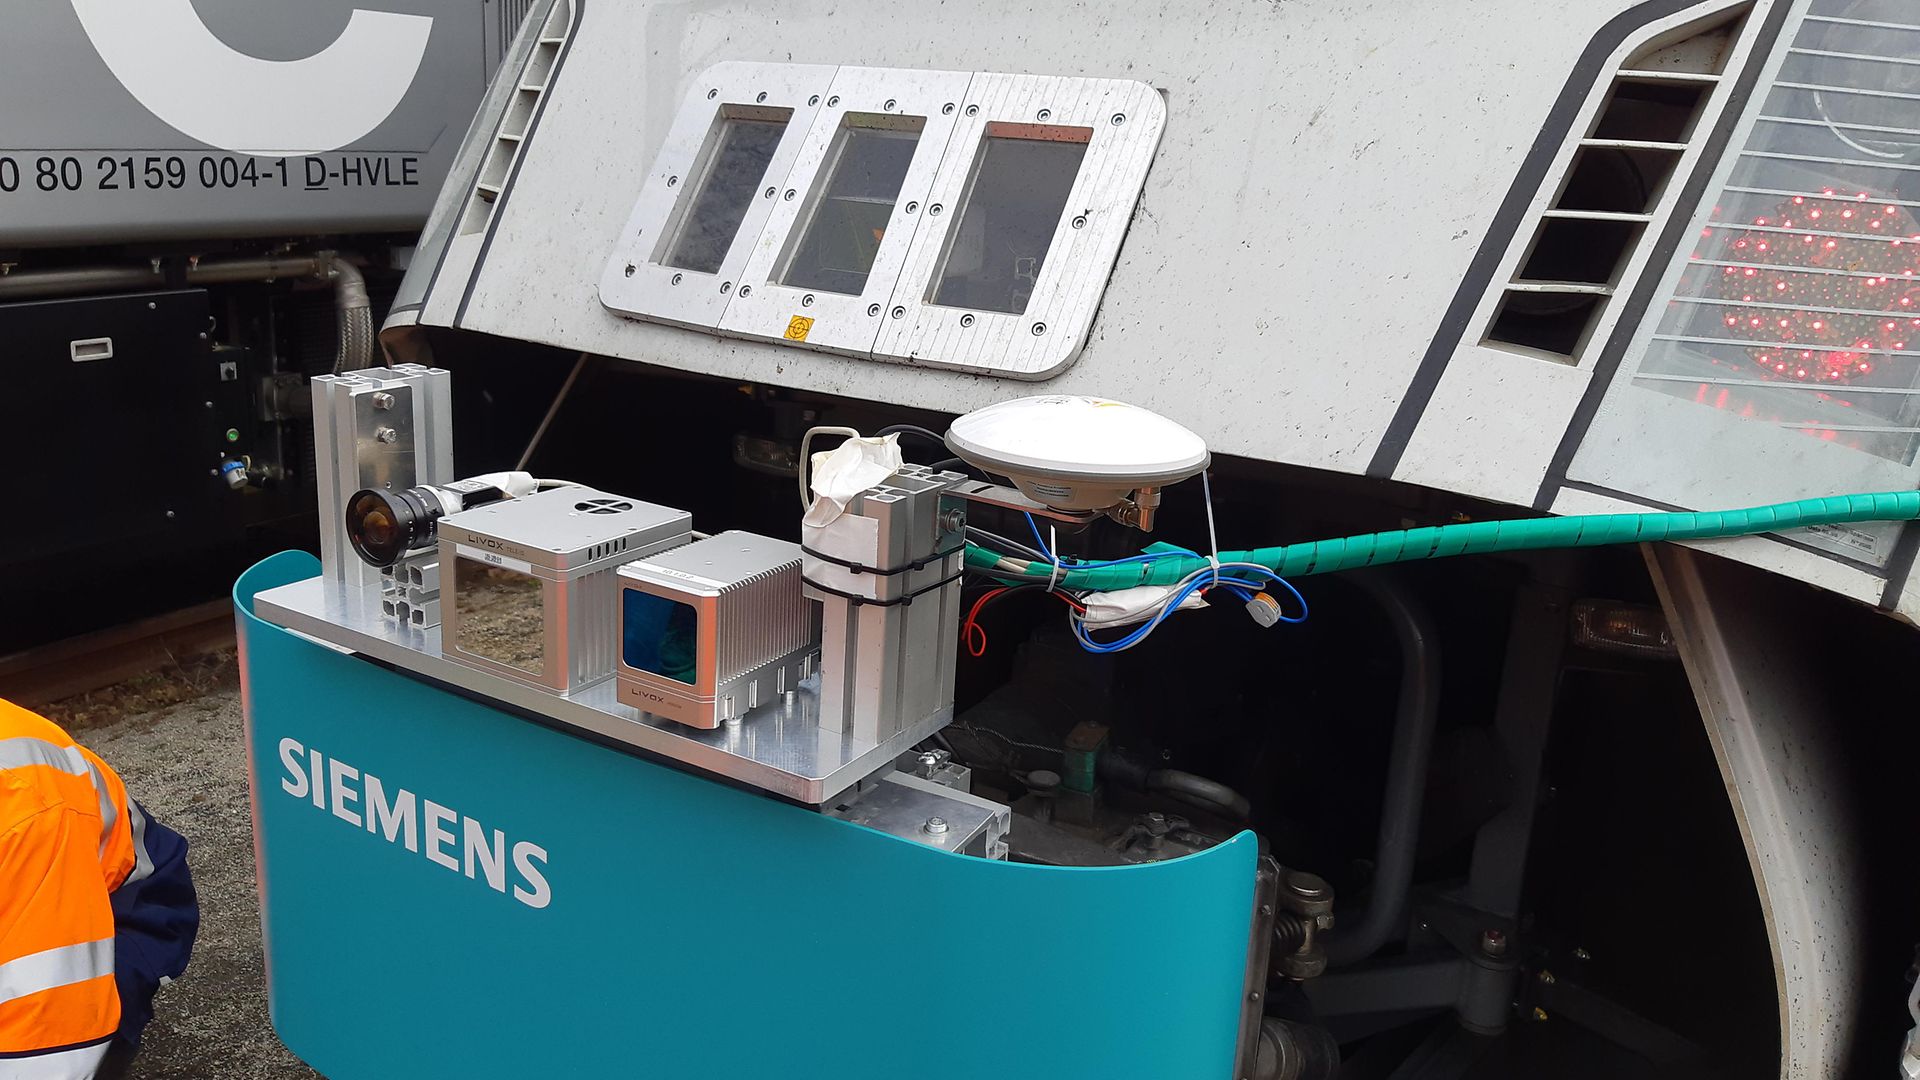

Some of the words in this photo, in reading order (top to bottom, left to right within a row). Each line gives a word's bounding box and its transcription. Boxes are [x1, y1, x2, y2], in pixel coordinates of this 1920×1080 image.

[36, 157, 82, 191] 80
[97, 157, 186, 190] 2159
[199, 157, 288, 188] 004-1
[304, 157, 419, 190] D-HVLE
[468, 534, 504, 551] LIVOX
[631, 688, 664, 703] LIVOX
[279, 737, 551, 909] SIEMENS
